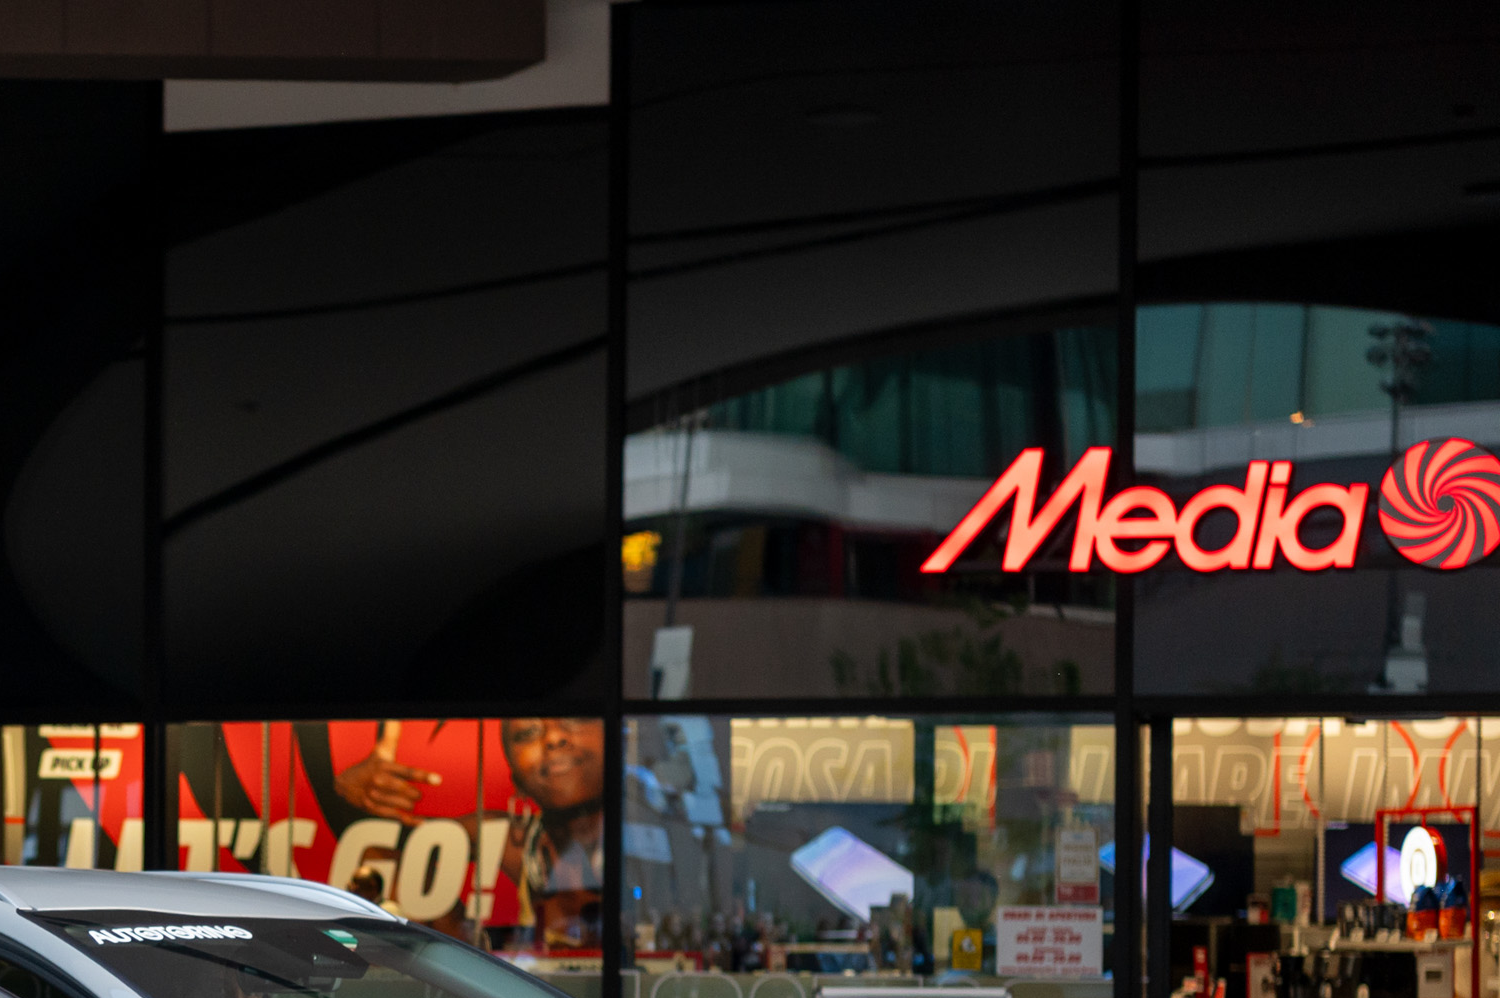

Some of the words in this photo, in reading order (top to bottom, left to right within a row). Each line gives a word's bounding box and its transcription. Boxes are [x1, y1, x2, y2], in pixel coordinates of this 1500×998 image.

[920, 446, 1369, 573] Media
[51, 757, 86, 771] PICK
[65, 818, 318, 877] T'S
[329, 818, 509, 922] GO!
[88, 925, 253, 945] AUTOTORINO
